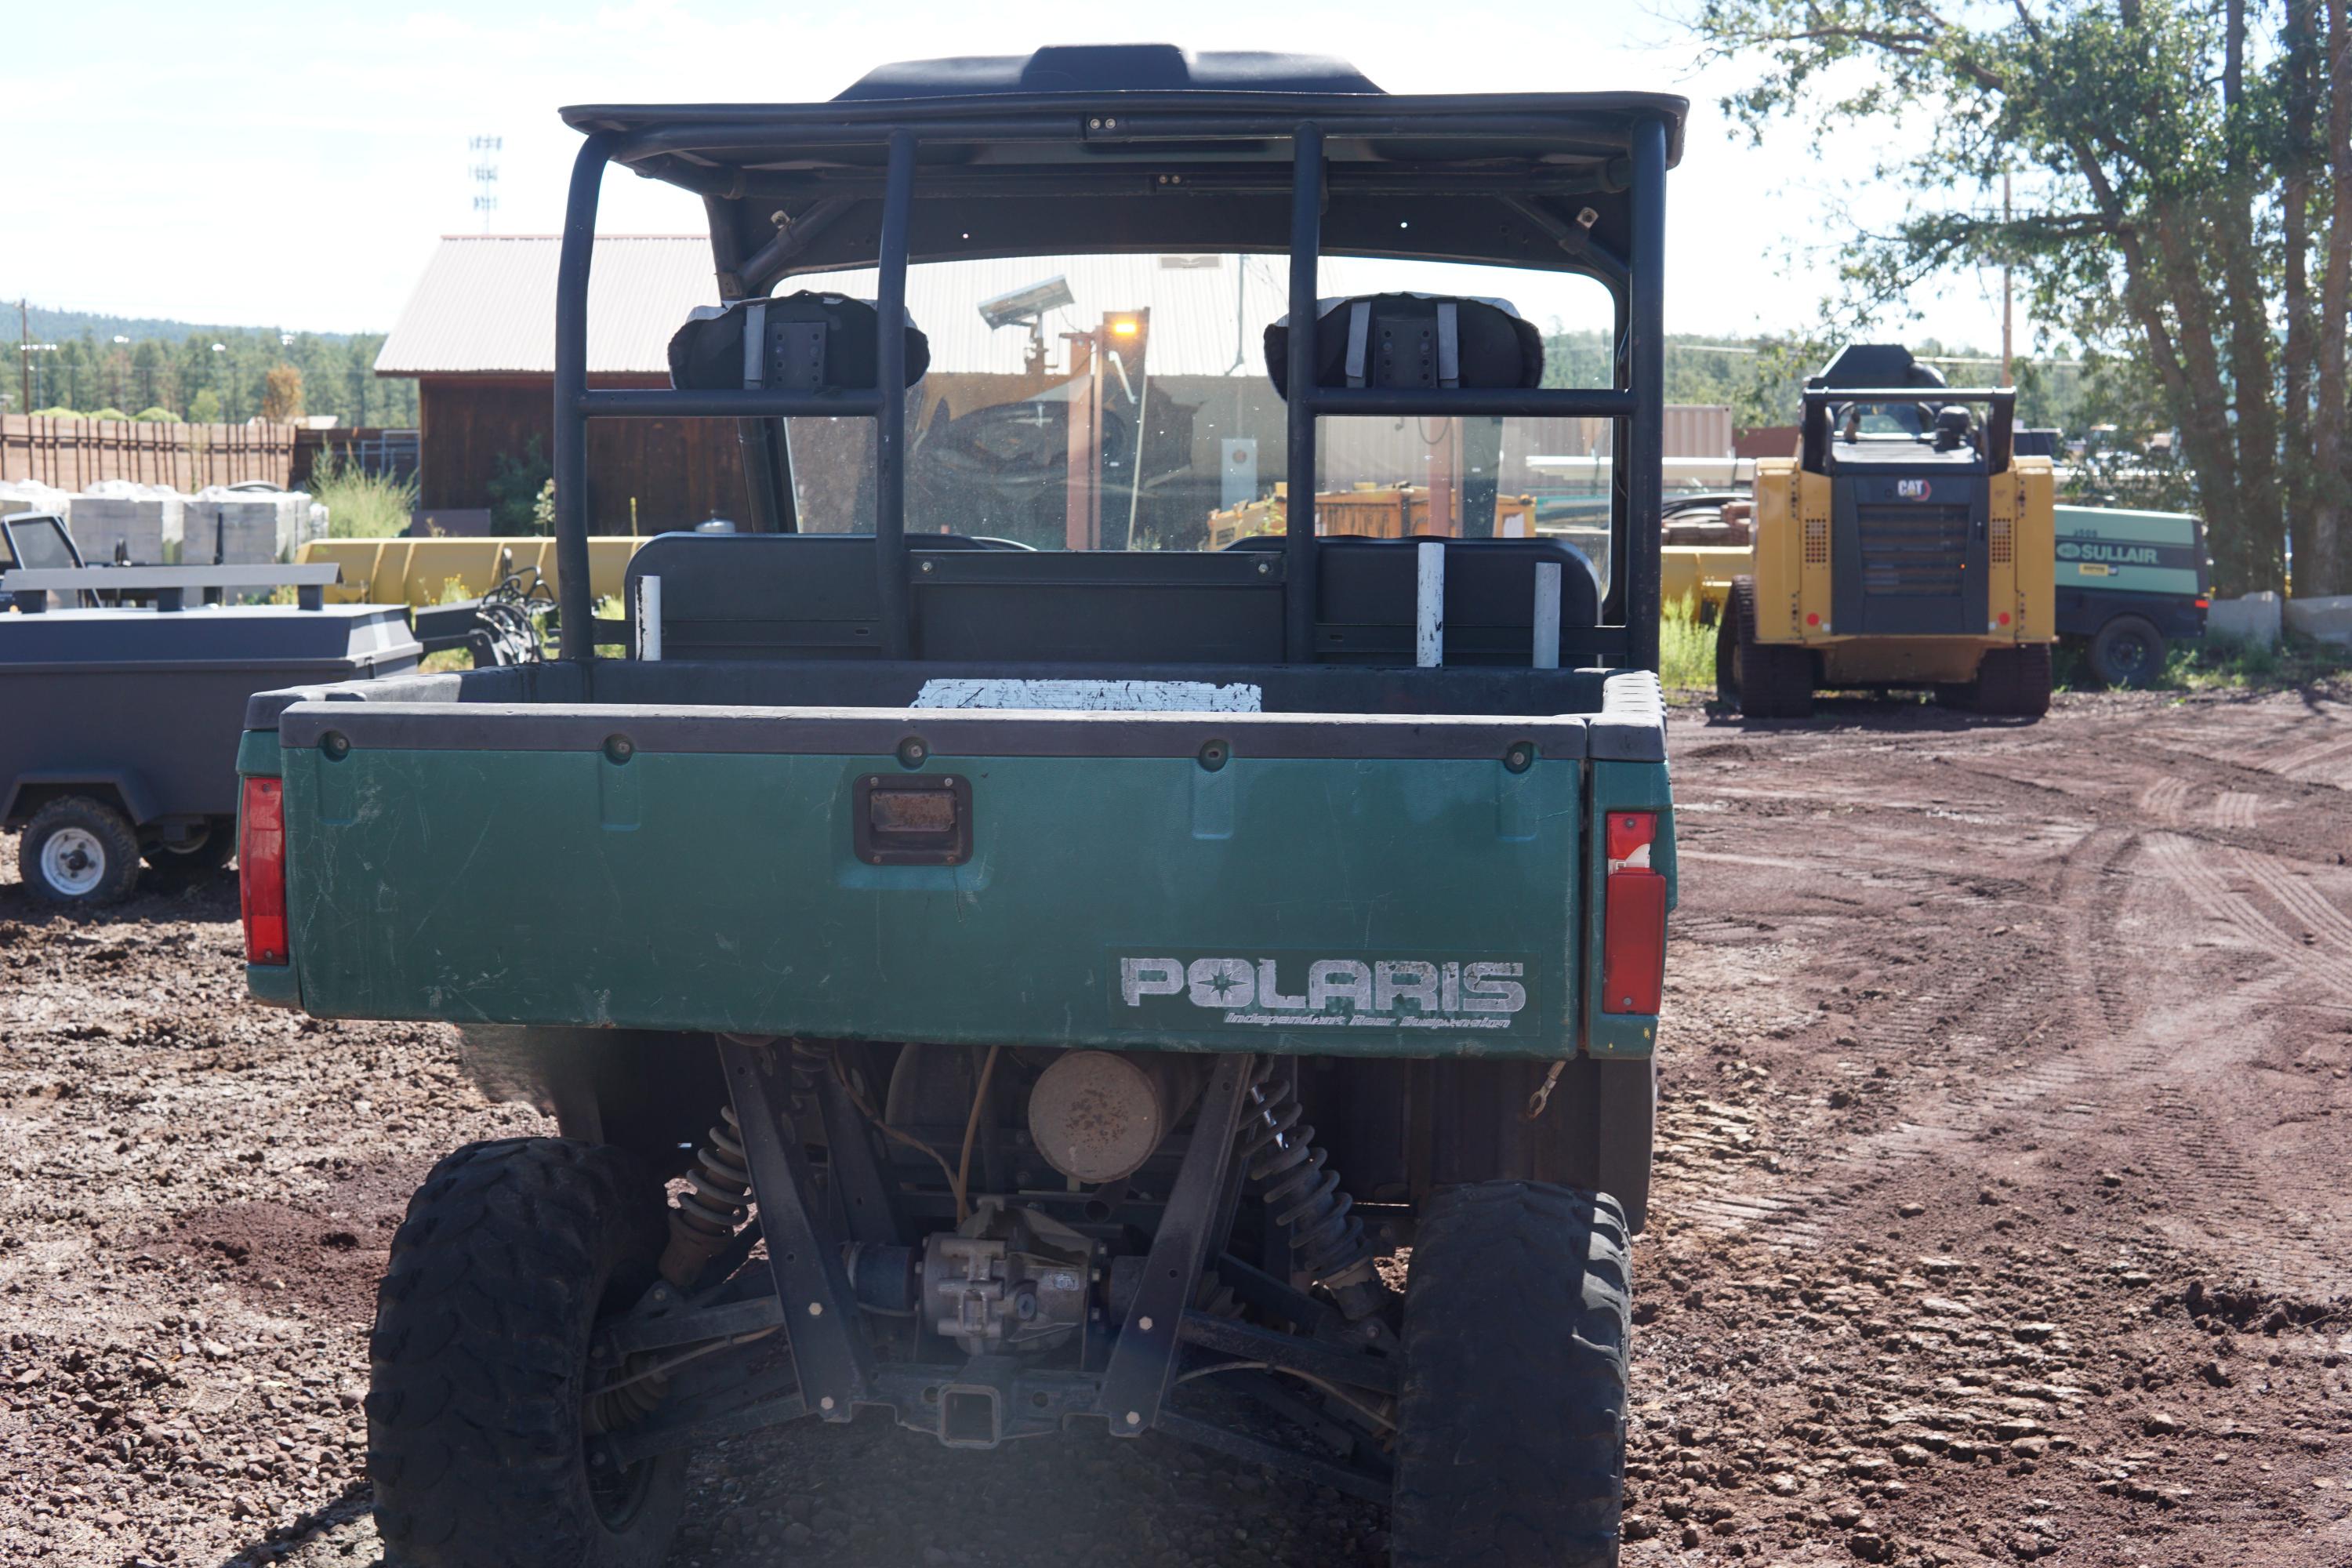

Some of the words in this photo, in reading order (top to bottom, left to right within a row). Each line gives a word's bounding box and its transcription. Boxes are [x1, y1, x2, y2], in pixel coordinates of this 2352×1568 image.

[1898, 480, 1923, 496] CAT
[2082, 543, 2158, 563] SULLAIR
[1121, 957, 1526, 1012] POLARIS
[1224, 1012, 1347, 1026] Independent
[1348, 1014, 1397, 1027] Rear
[1399, 1016, 1512, 1029] Suspension
